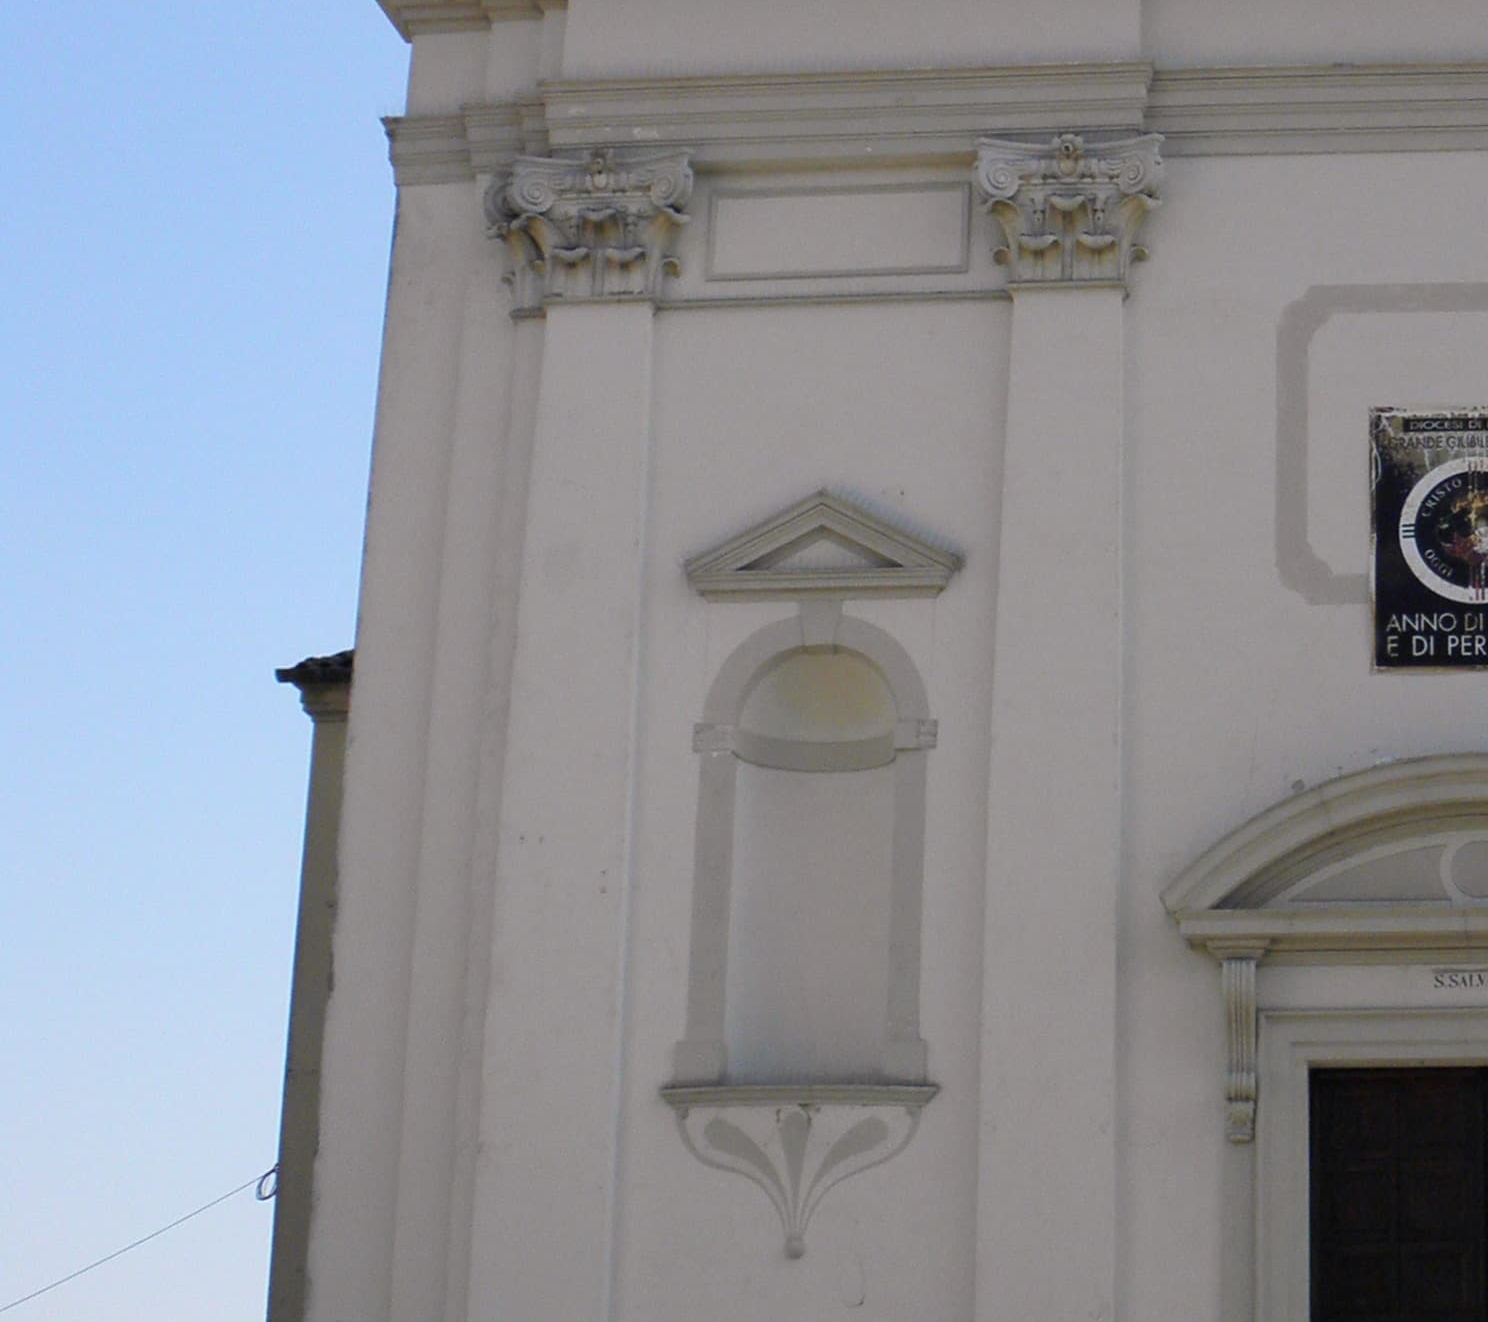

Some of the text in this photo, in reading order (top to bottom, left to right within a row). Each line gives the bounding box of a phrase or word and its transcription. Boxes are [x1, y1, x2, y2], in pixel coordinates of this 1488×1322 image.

[1409, 420, 1464, 430] DIOCESI
[1468, 419, 1483, 429] DI
[1391, 435, 1443, 450] GRANDE
[1421, 478, 1463, 517] CRISTO
[1424, 548, 1453, 578] OGGI
[1386, 612, 1458, 632] ANNO
[1464, 612, 1484, 631] DI
[1387, 636, 1399, 657] E
[1412, 635, 1435, 656] DI
